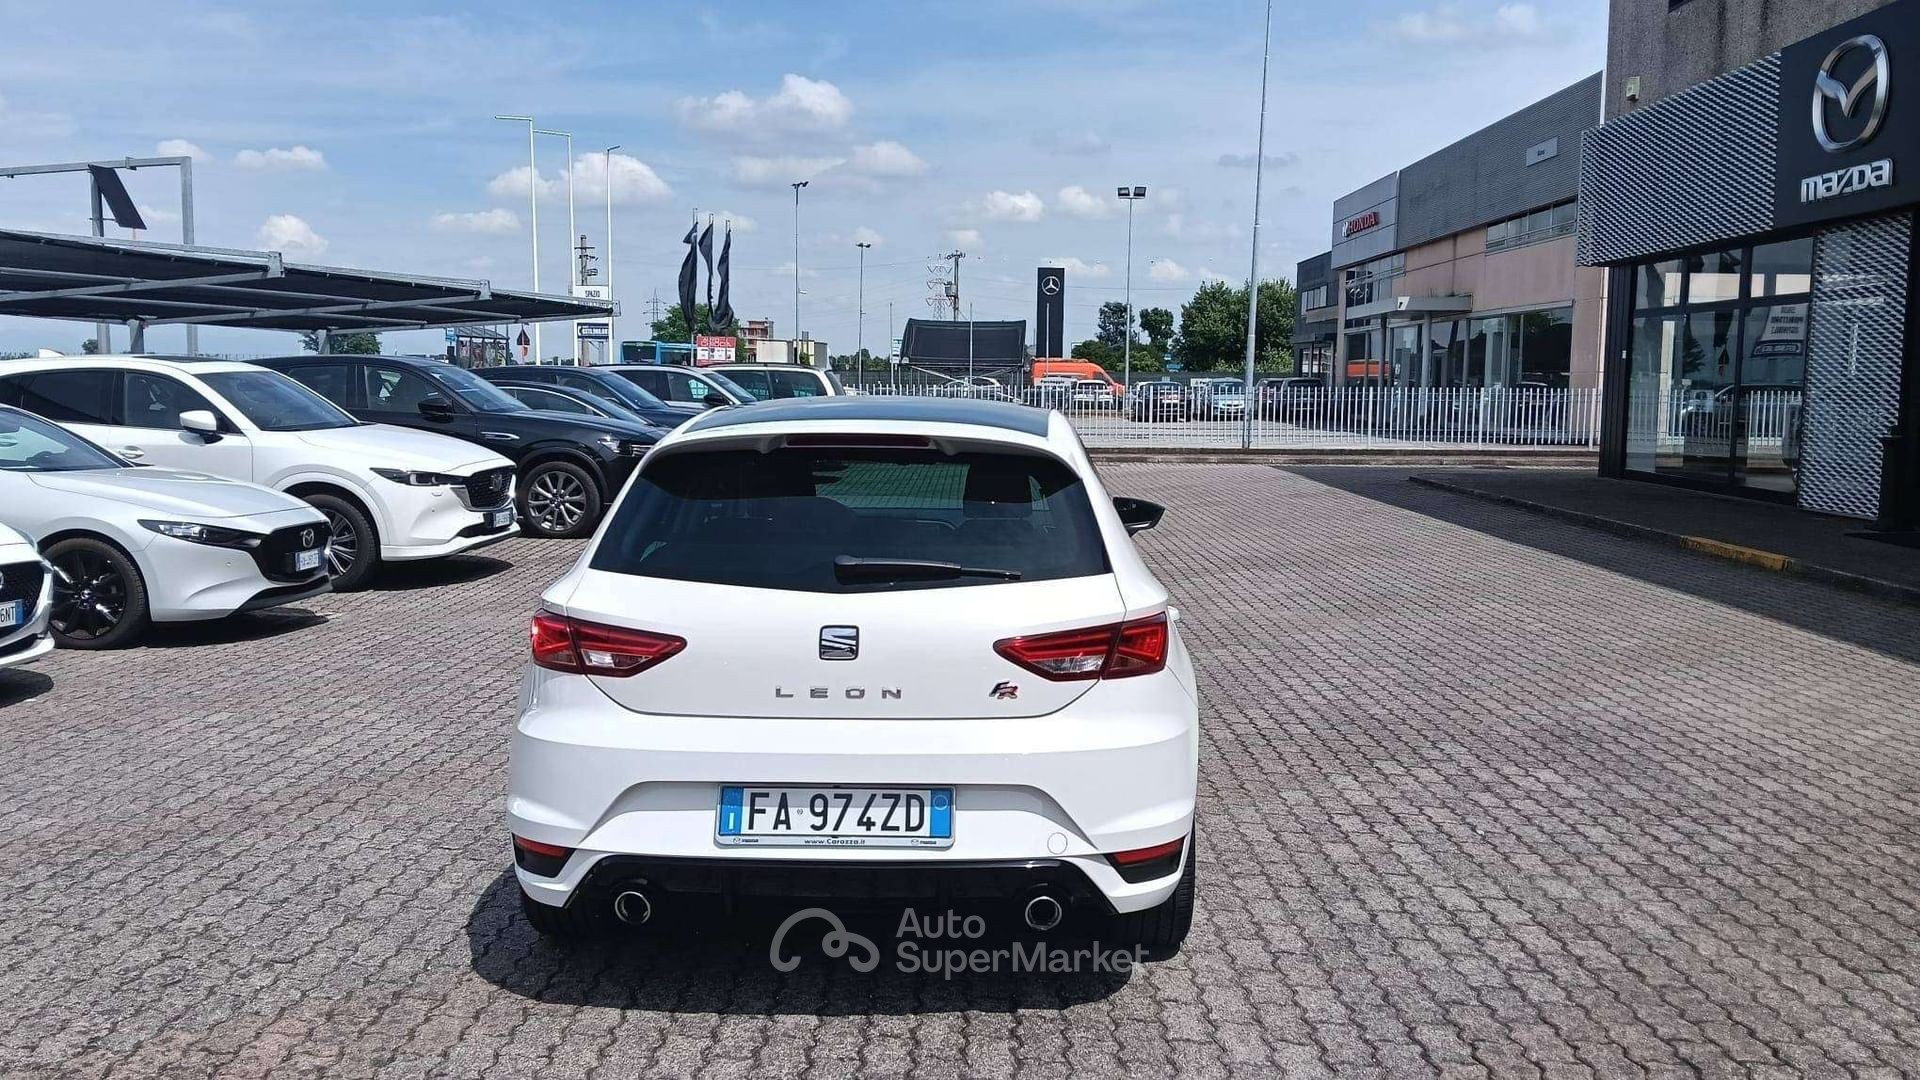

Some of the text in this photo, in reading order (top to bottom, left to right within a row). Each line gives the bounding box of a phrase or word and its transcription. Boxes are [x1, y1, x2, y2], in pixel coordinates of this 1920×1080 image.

[1348, 211, 1377, 233] HONDA
[775, 686, 902, 699] LEON
[989, 681, 1018, 700] FR
[748, 792, 791, 830] FA
[810, 793, 925, 832] 974ZD
